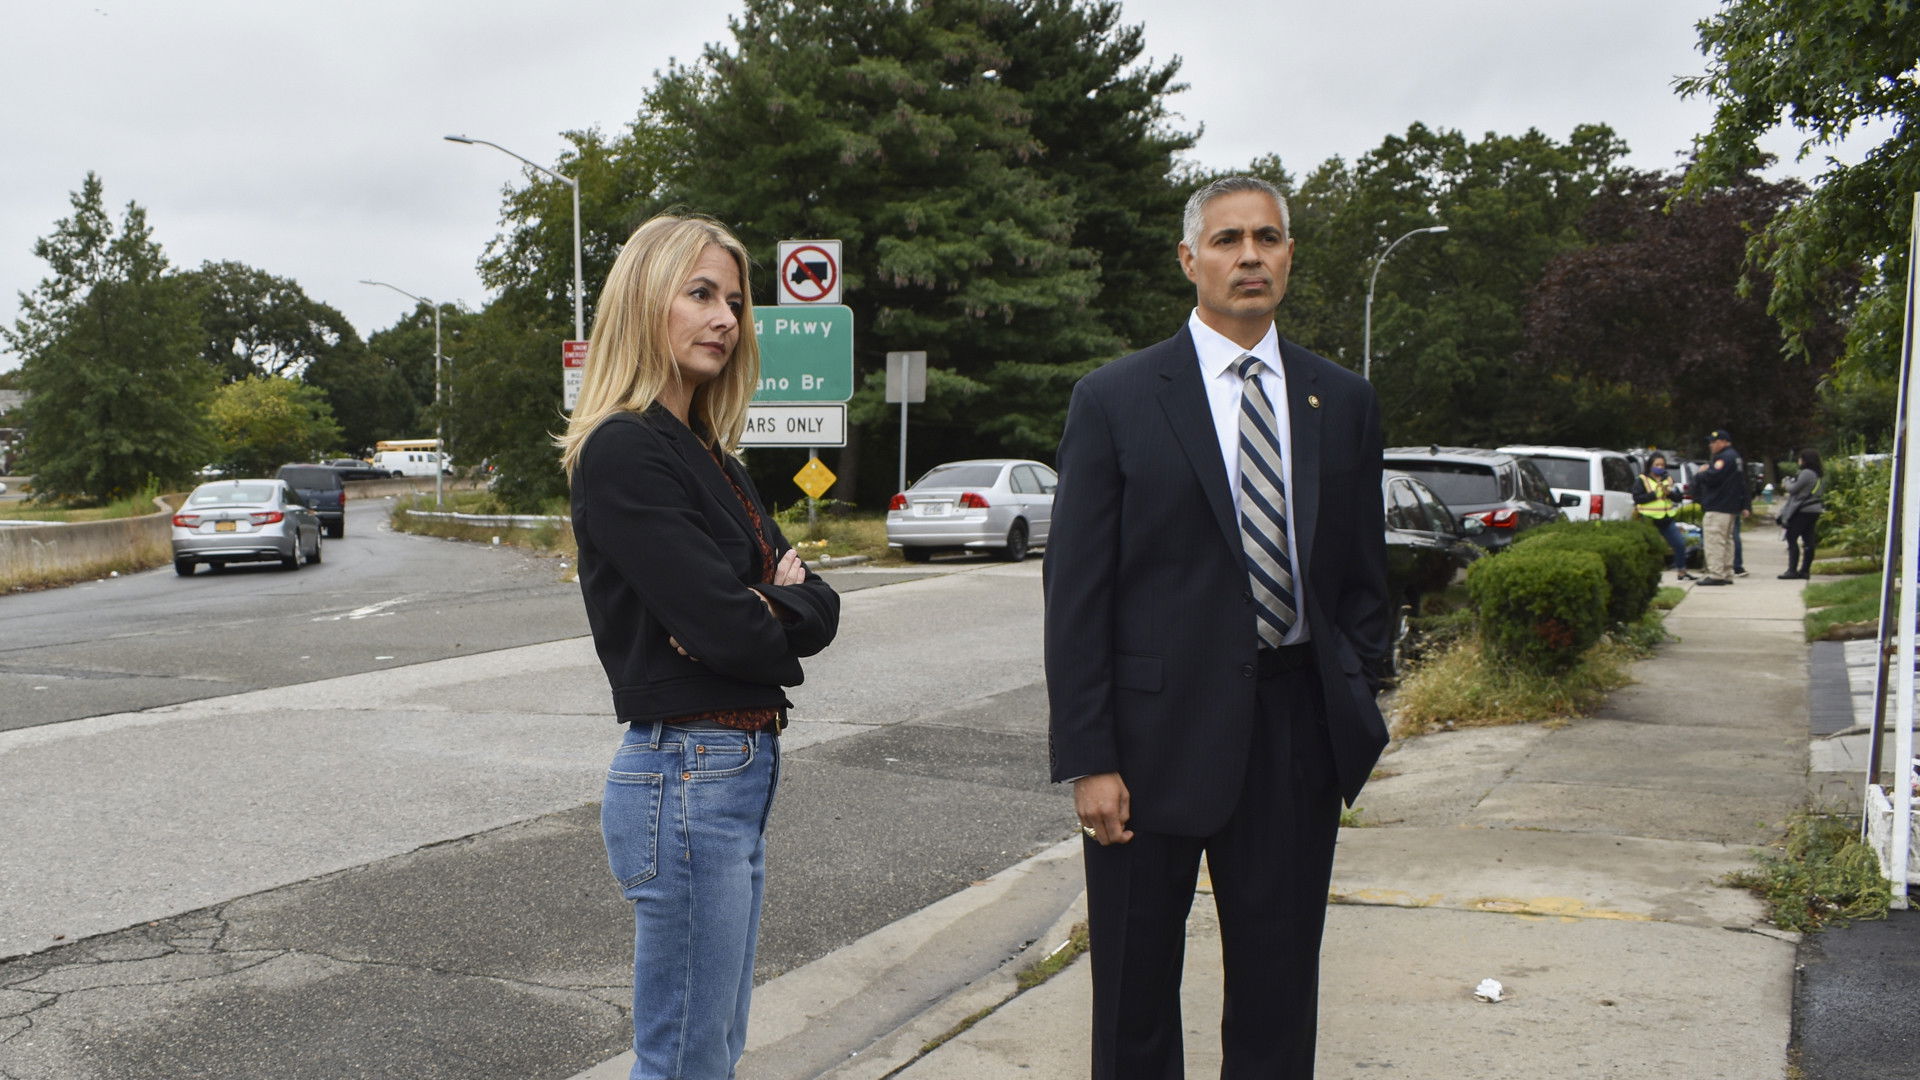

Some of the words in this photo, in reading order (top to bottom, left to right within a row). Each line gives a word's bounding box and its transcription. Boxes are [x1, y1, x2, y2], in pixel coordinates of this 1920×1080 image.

[775, 318, 833, 338] Pkwy
[756, 377, 790, 391] ano
[801, 373, 825, 391] Br
[746, 417, 776, 433] ARS
[786, 417, 824, 433] ONLY
